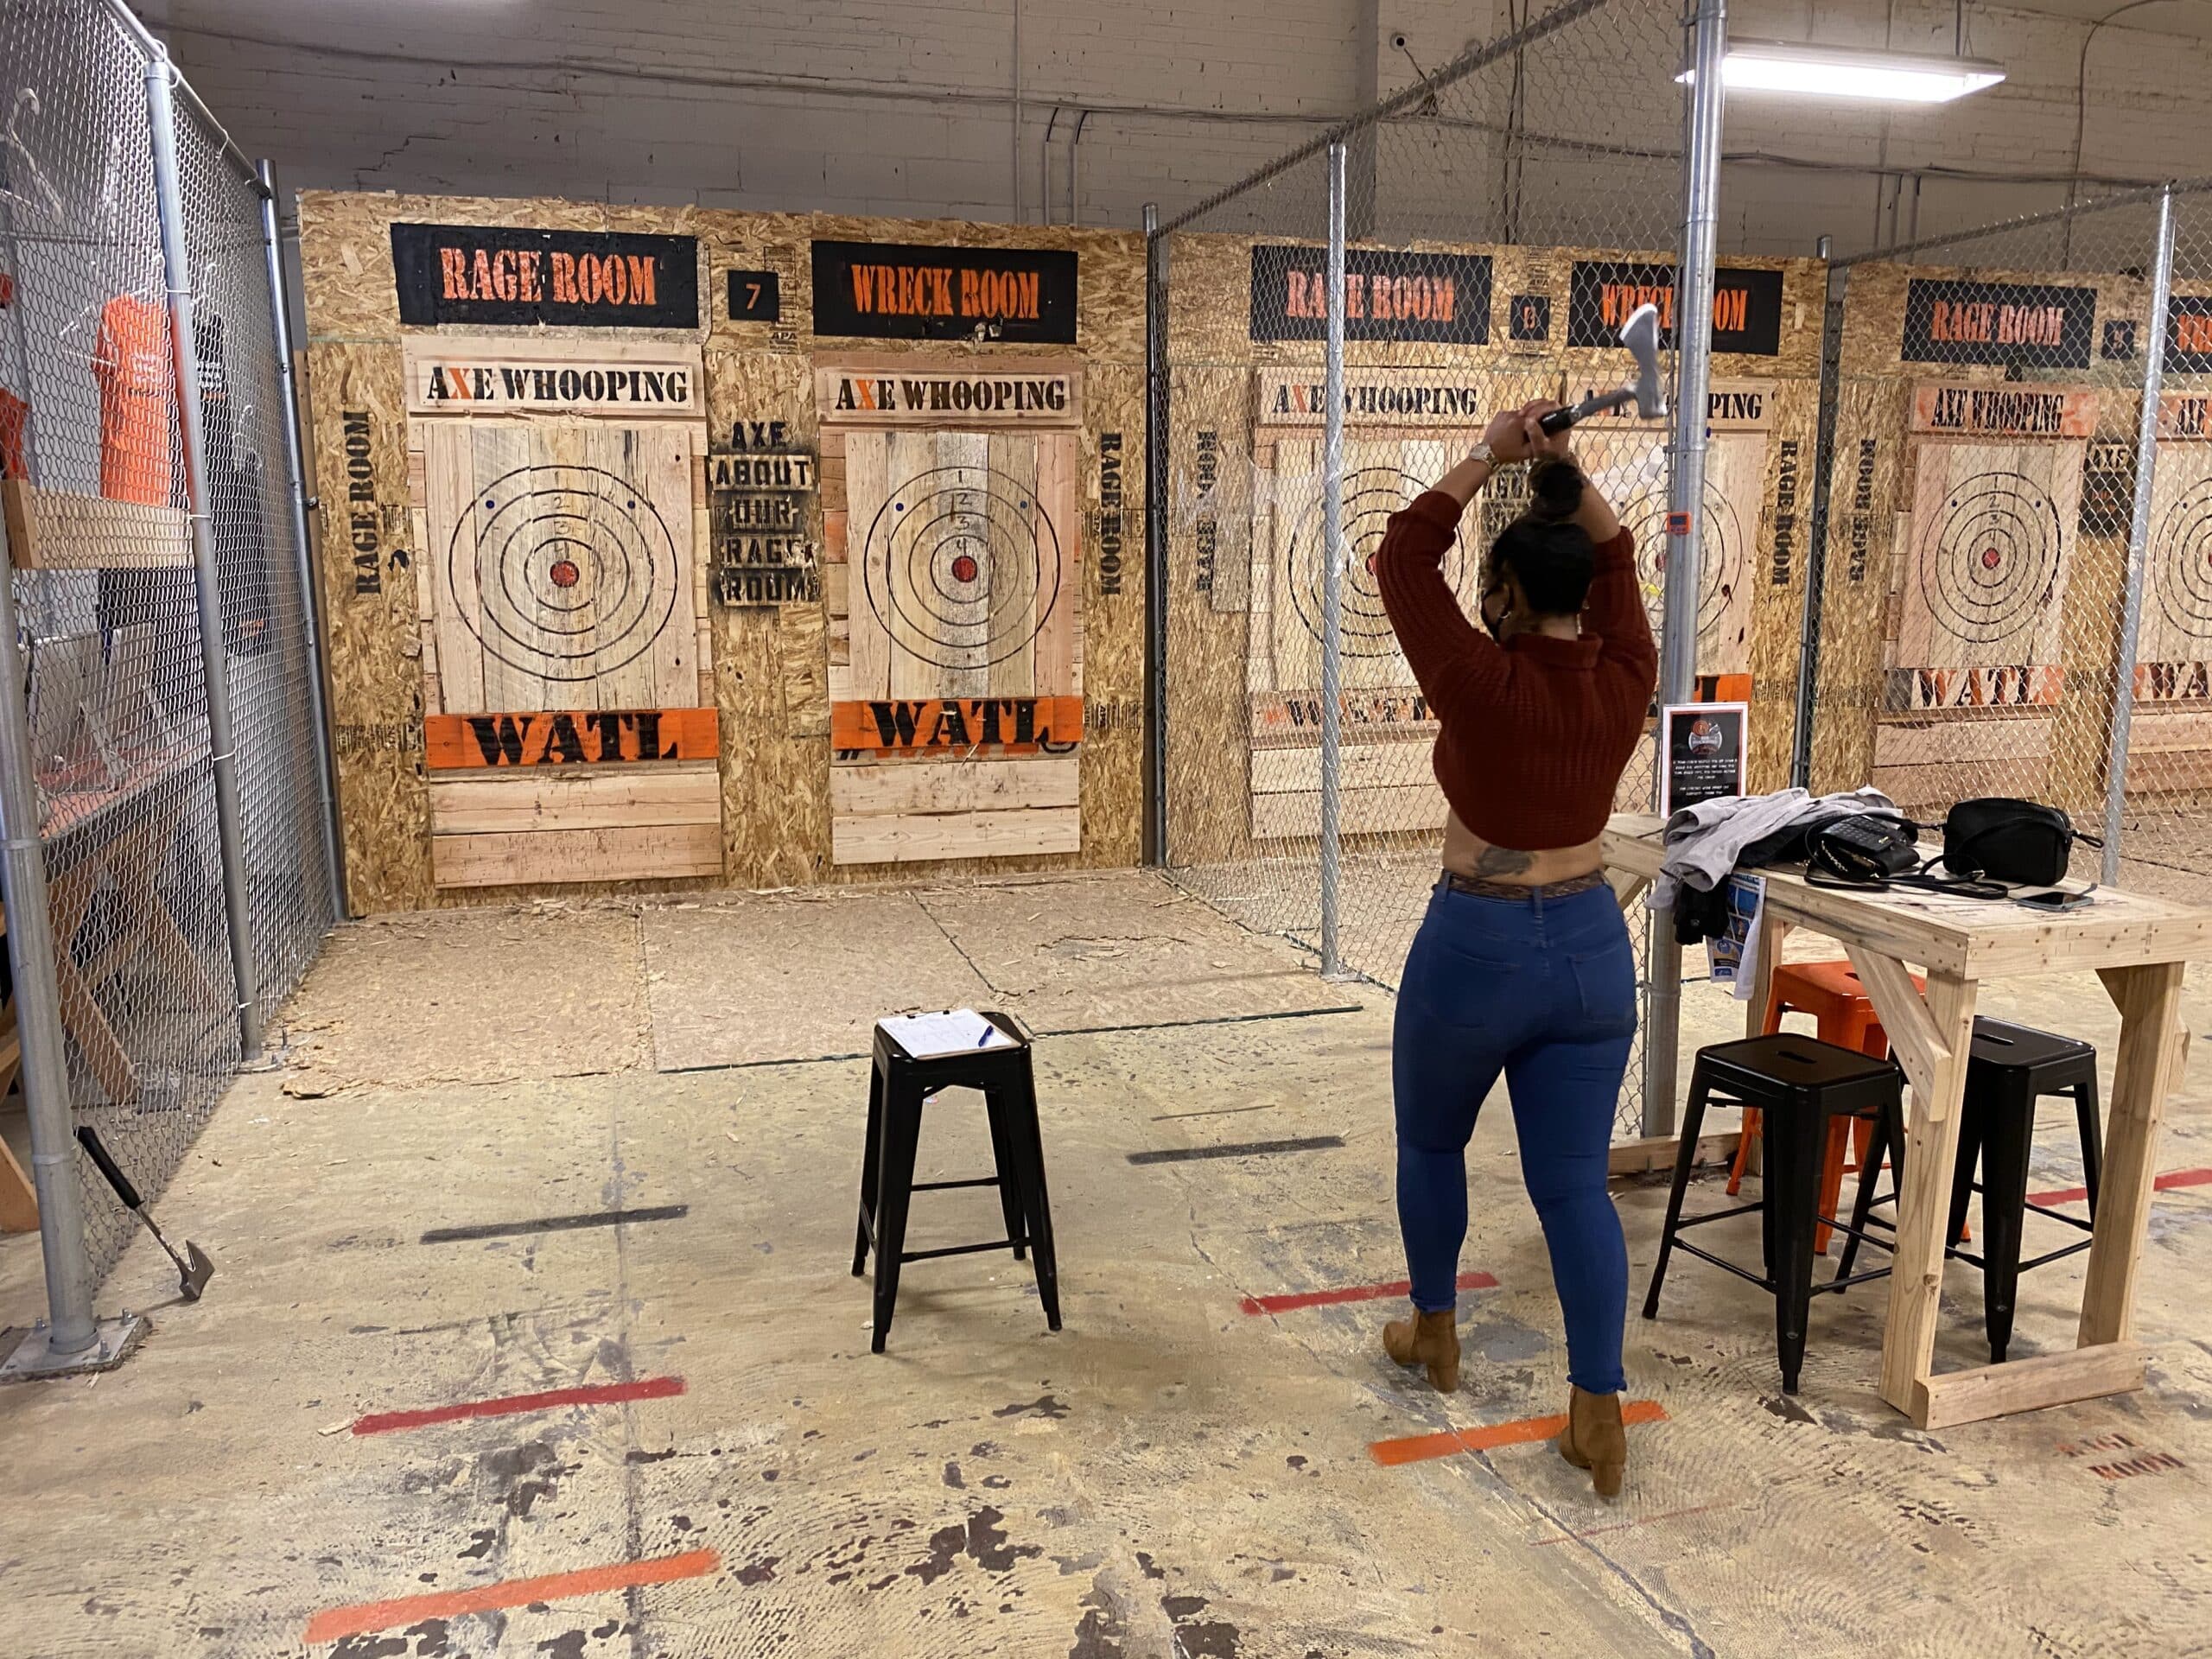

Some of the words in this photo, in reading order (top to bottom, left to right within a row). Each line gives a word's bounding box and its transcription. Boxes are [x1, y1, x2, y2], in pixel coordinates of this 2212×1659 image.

[439, 248, 543, 302] RAGE
[550, 252, 658, 305] ROOM
[746, 283, 760, 309] 7
[851, 264, 954, 316] WRECK
[961, 268, 1039, 319] ROOM
[1287, 270, 1364, 318] RAE
[1372, 275, 1455, 322] ROOM
[1931, 301, 1994, 343] RAGE
[1998, 304, 2064, 346] ROOM
[426, 366, 494, 400] AXE
[501, 369, 688, 404] WHOOPING
[835, 378, 895, 411] AXE
[902, 380, 1065, 411] WHOOPING
[1272, 385, 1326, 415] AXE
[1931, 388, 1968, 428] AXE
[1971, 391, 2064, 432] WHOOPING
[343, 410, 375, 502] ROOM
[732, 422, 786, 450] AXE
[715, 460, 810, 486] ABOUT
[957, 469, 963, 484] 1
[1100, 433, 1122, 508] RAGE
[1777, 441, 1798, 507] RAGE
[553, 496, 570, 510] 2
[734, 499, 791, 524] OUR
[956, 493, 973, 505] 2
[1988, 494, 2000, 508] 2
[956, 516, 970, 531] 3
[351, 512, 381, 594] RAGE
[956, 537, 967, 556] 4
[1100, 515, 1122, 595] ROOM
[1772, 515, 1794, 585] ROOM
[1918, 666, 2034, 708] WATL
[466, 713, 679, 766] WATL
[869, 699, 1050, 747] WATL
